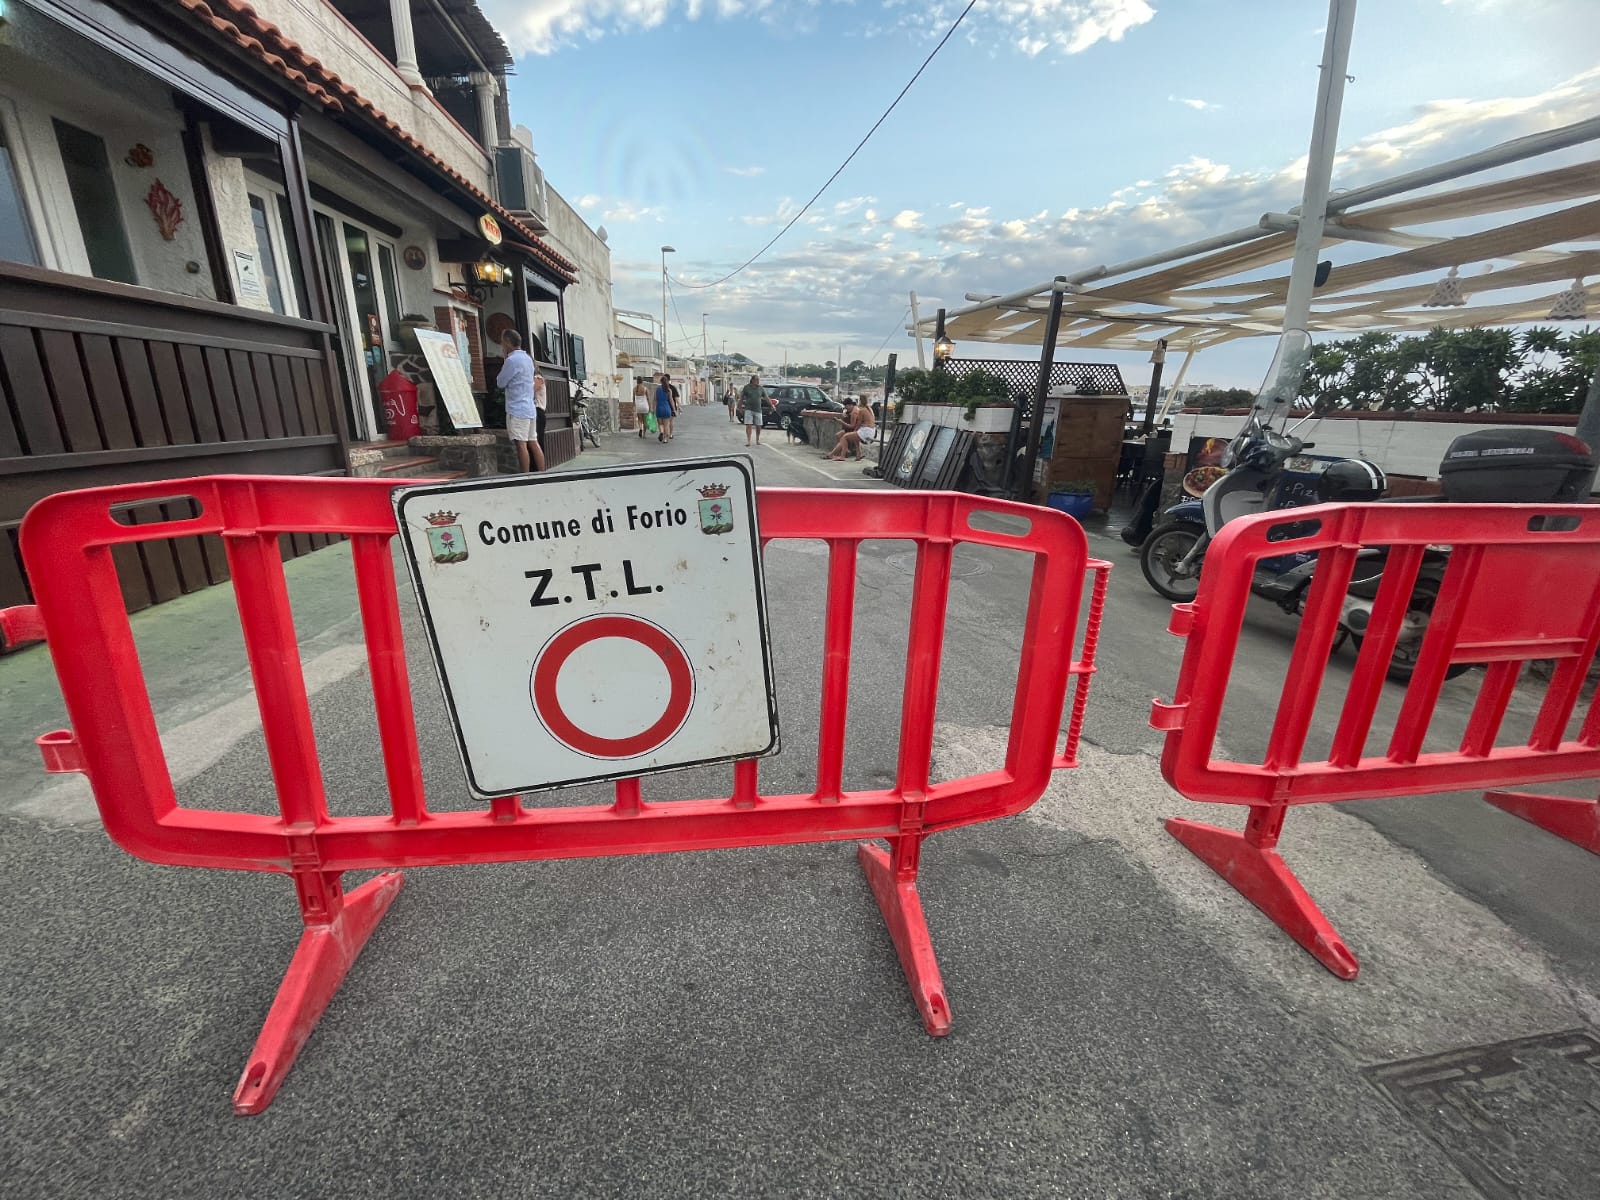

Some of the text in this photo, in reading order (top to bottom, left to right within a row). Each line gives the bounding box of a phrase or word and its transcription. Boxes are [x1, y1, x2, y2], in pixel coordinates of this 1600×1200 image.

[478, 502, 687, 546] Comune di Forio
[524, 559, 664, 607] Z.T.L.
